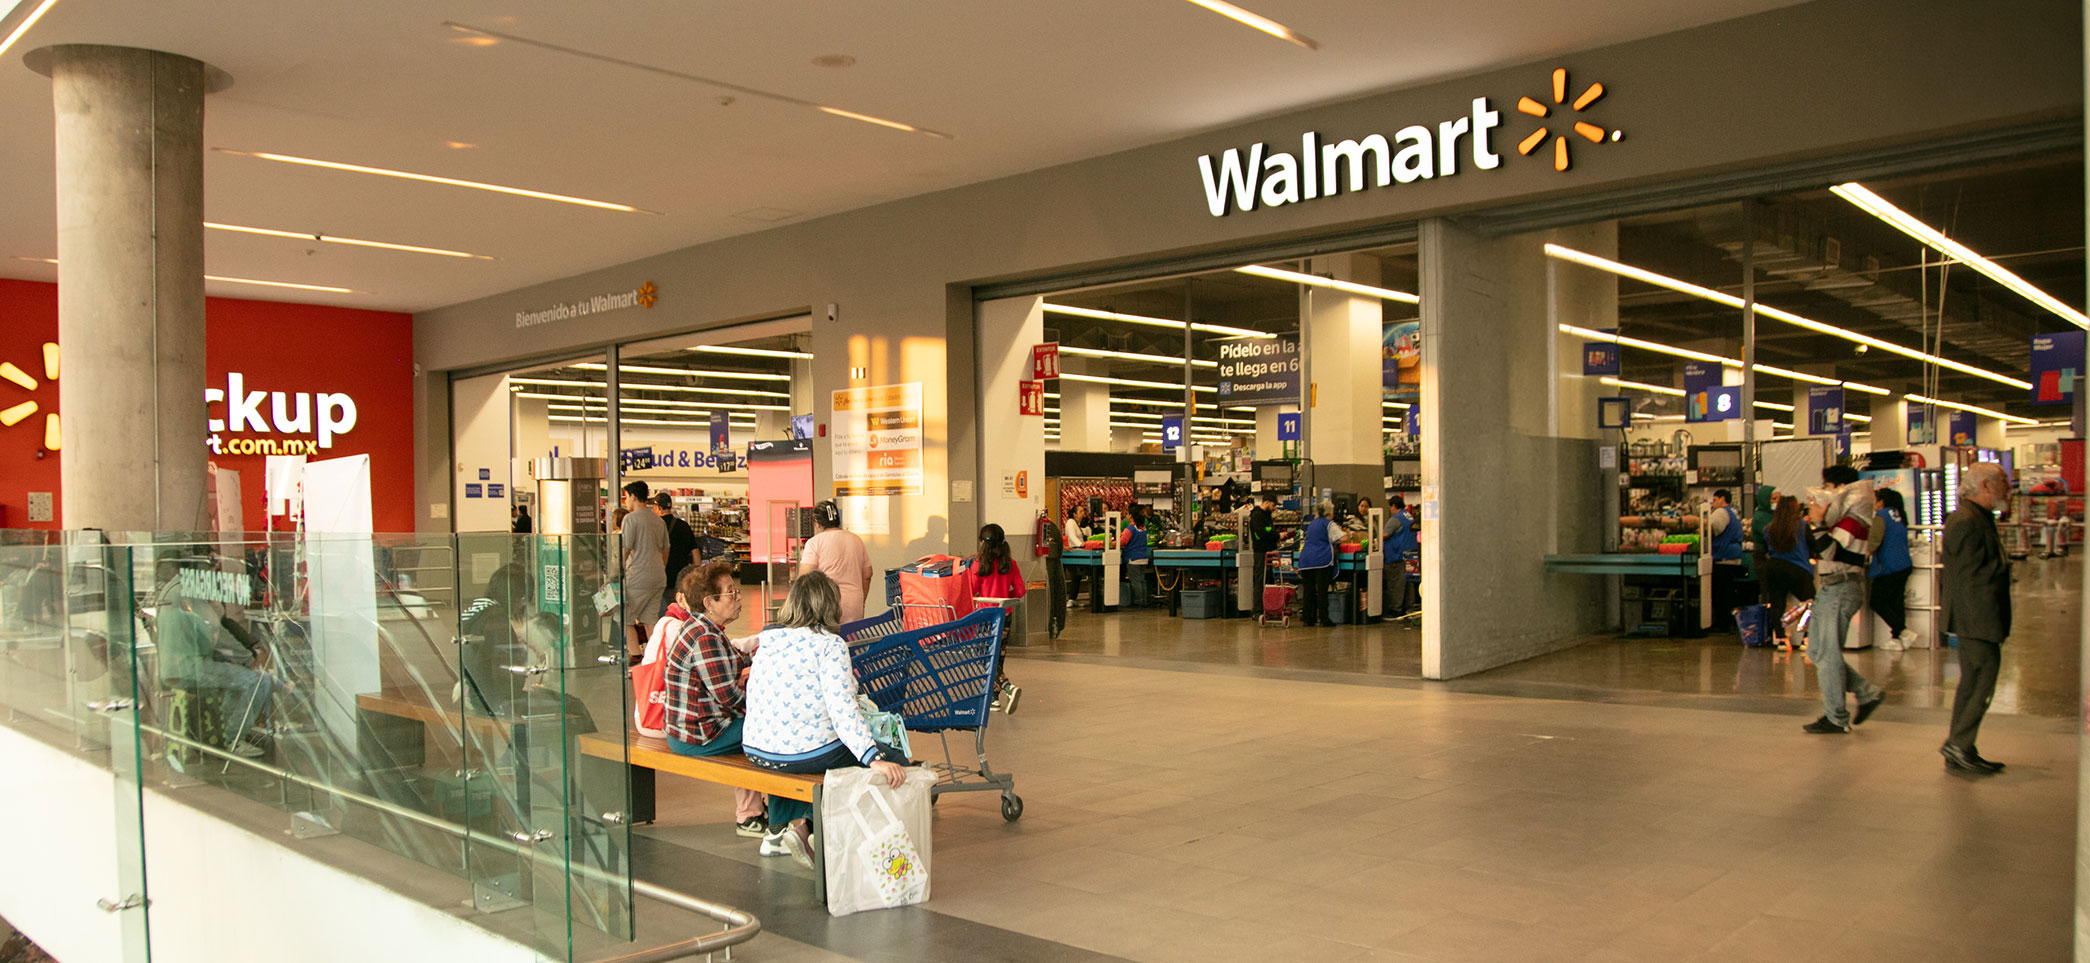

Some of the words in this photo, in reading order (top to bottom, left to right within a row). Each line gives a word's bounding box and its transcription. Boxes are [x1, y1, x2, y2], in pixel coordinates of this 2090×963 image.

[1198, 97, 1499, 217] Walmart
[515, 301, 569, 328] Bienvenido
[569, 304, 577, 317] a
[578, 301, 590, 315] tu
[590, 288, 638, 313] Walmart
[1220, 342, 1262, 359] Pídelo
[1263, 343, 1280, 355] en
[1282, 339, 1295, 354] la
[1219, 364, 1234, 377] te
[1235, 361, 1268, 377] llega
[1269, 361, 1287, 374] en
[1233, 382, 1265, 392] Descarga
[1265, 381, 1272, 389] la
[1273, 381, 1288, 391] app
[205, 372, 357, 448] ckup
[1716, 393, 1732, 412] 8
[1167, 426, 1180, 441] 12
[1283, 420, 1296, 433] 11
[880, 434, 915, 444] MoneyGram
[678, 450, 690, 468] &
[879, 452, 893, 466] ria
